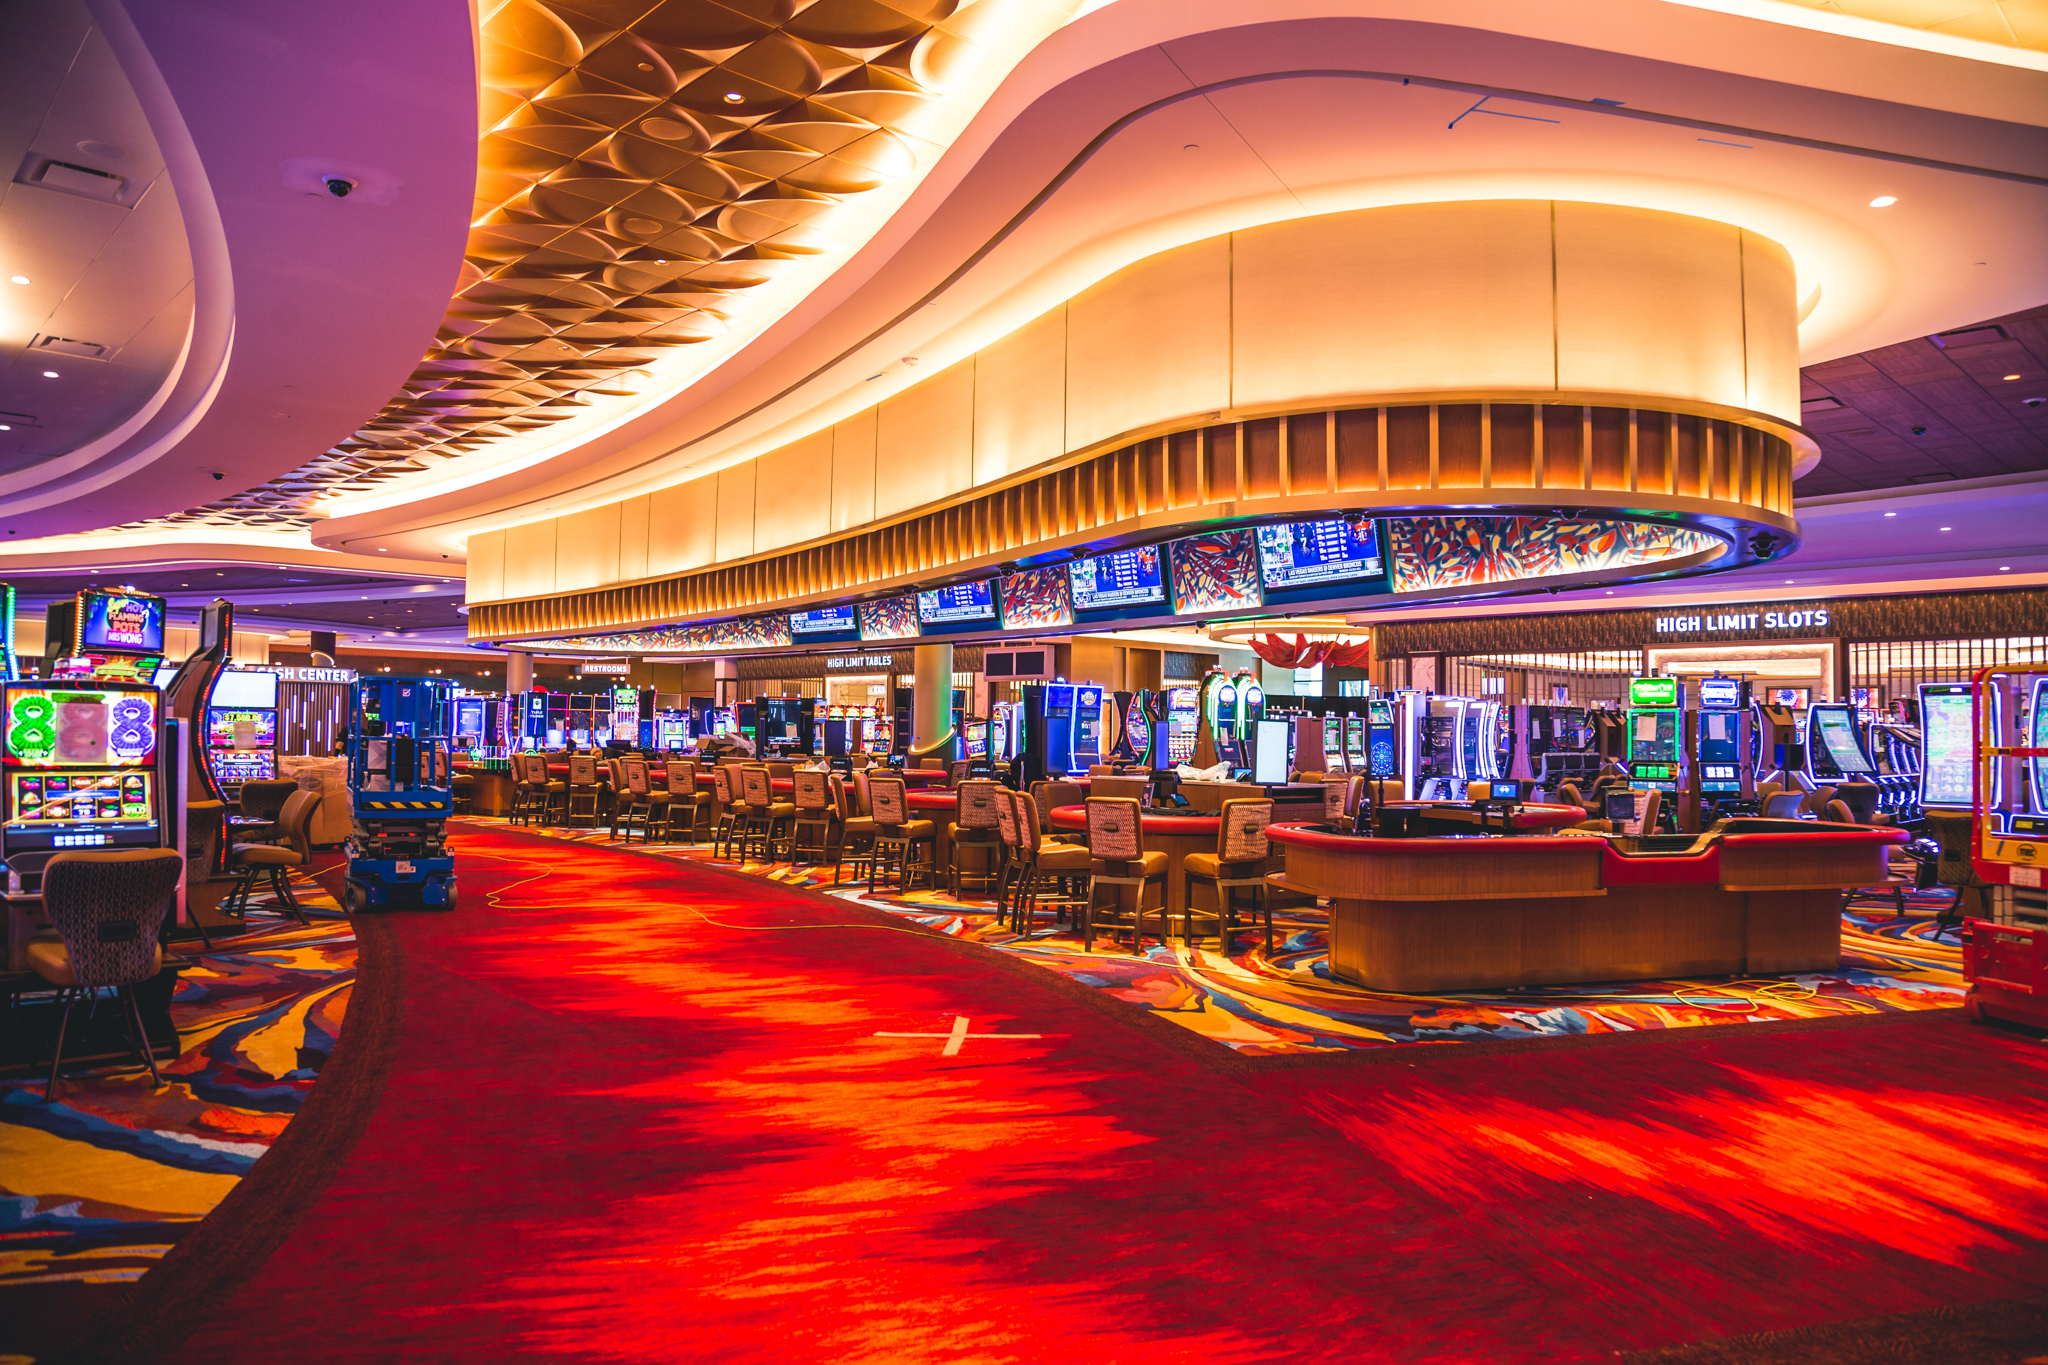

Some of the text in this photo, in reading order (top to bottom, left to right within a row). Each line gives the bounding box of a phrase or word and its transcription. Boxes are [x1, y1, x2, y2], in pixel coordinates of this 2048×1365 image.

[1343, 560, 1362, 569] BRONCOS
[125, 603, 144, 613] HOT
[108, 611, 144, 622] FLAMING
[1656, 609, 1828, 633] HIGH LIMIT SLOTS
[112, 620, 141, 633] POTS
[120, 632, 143, 644] WONG
[827, 655, 892, 669] HIGH LIMIT TABLES
[584, 665, 628, 673] RESTROOMS
[298, 668, 349, 682] CENTER
[123, 806, 146, 816] WILD
